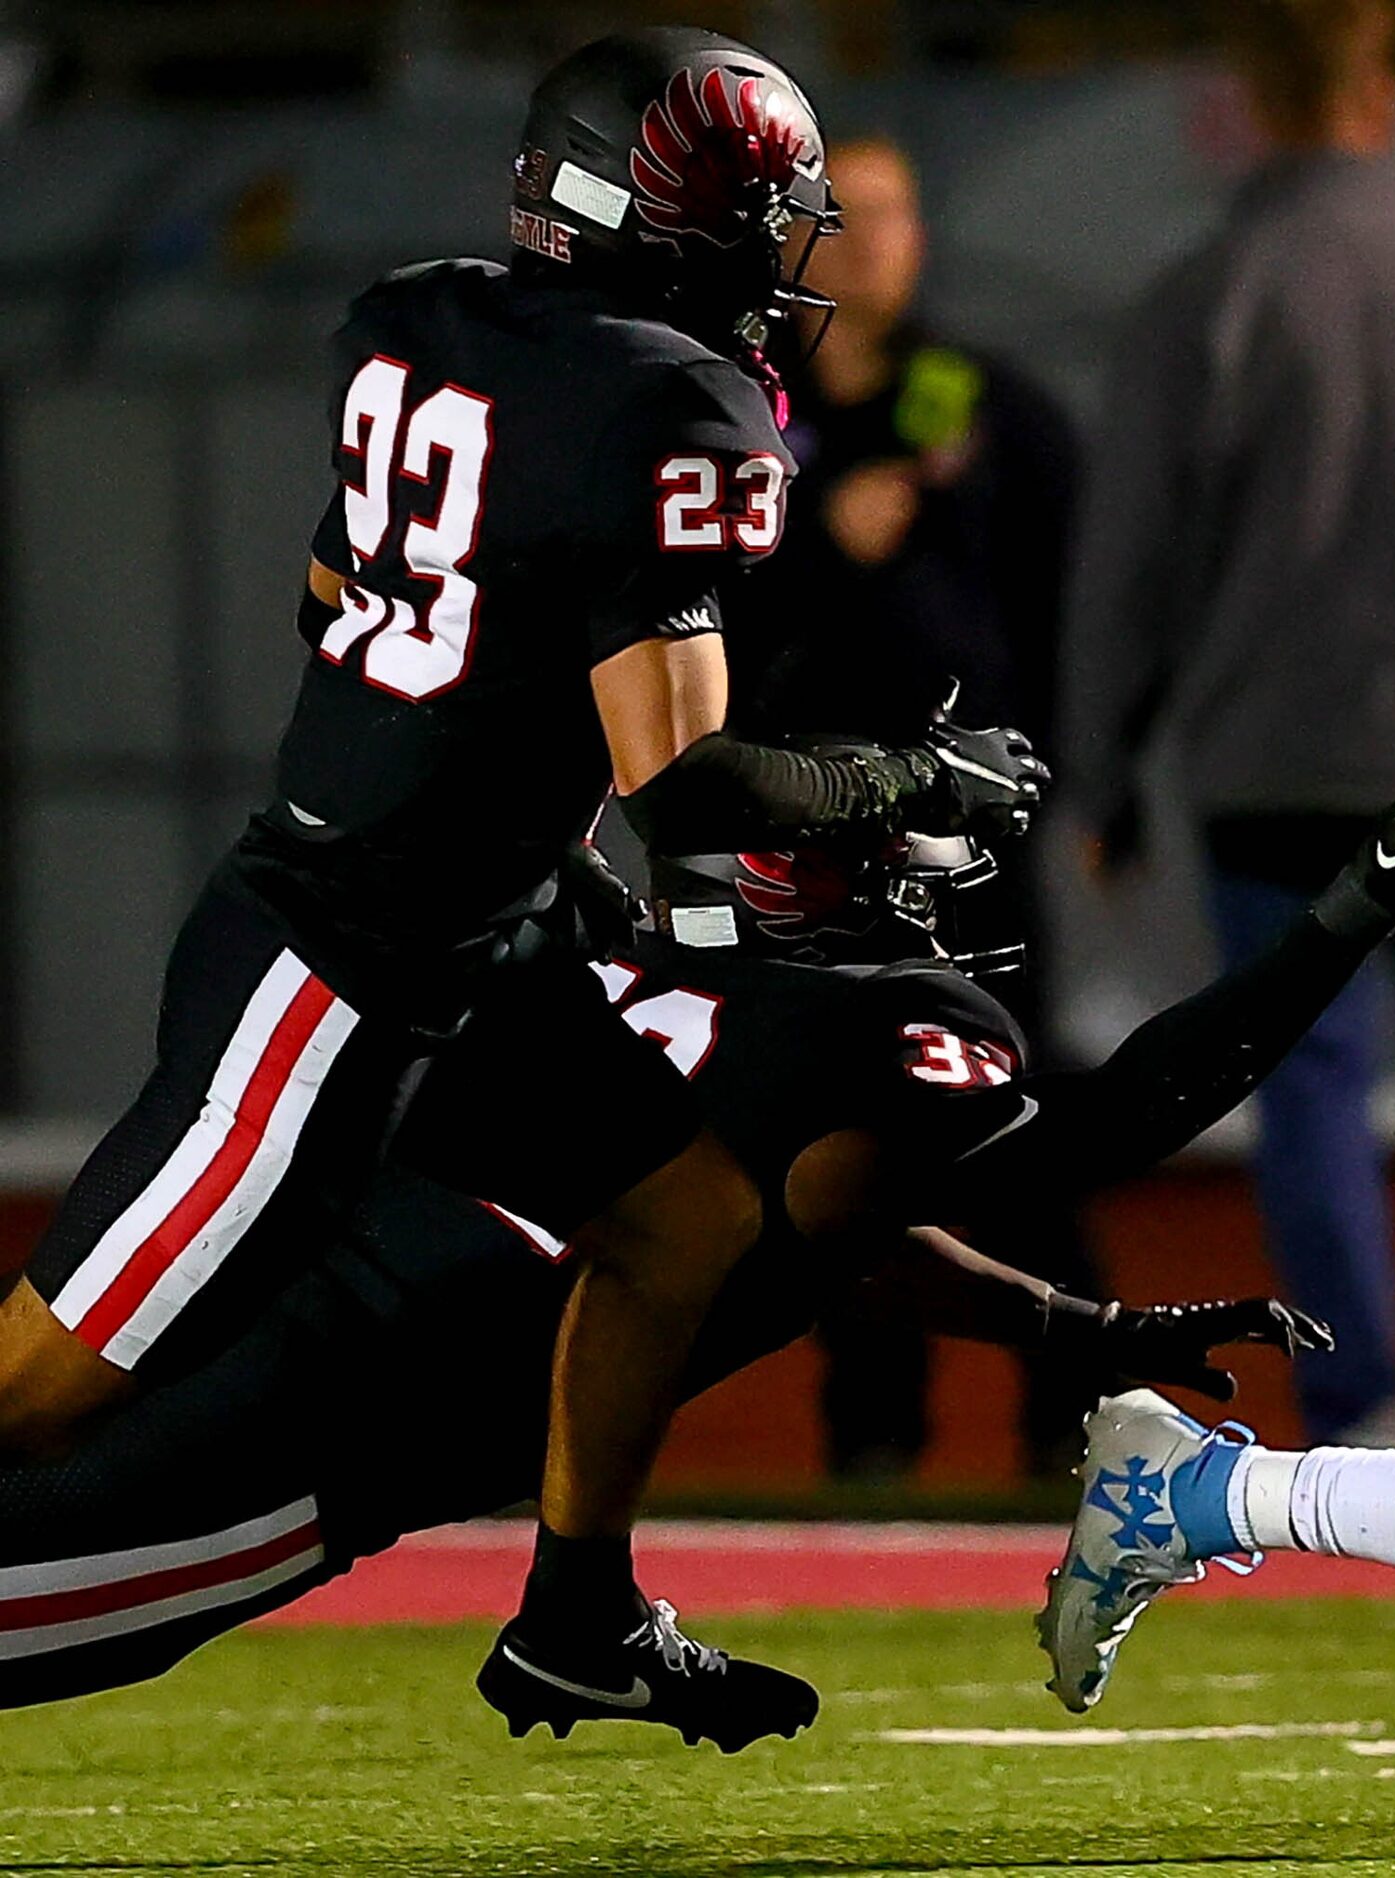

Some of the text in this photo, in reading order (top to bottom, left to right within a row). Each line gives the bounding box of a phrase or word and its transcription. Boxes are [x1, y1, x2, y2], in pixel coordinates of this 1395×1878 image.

[510, 206, 580, 264] GYLE
[318, 352, 497, 705] 23
[654, 450, 790, 552] 23
